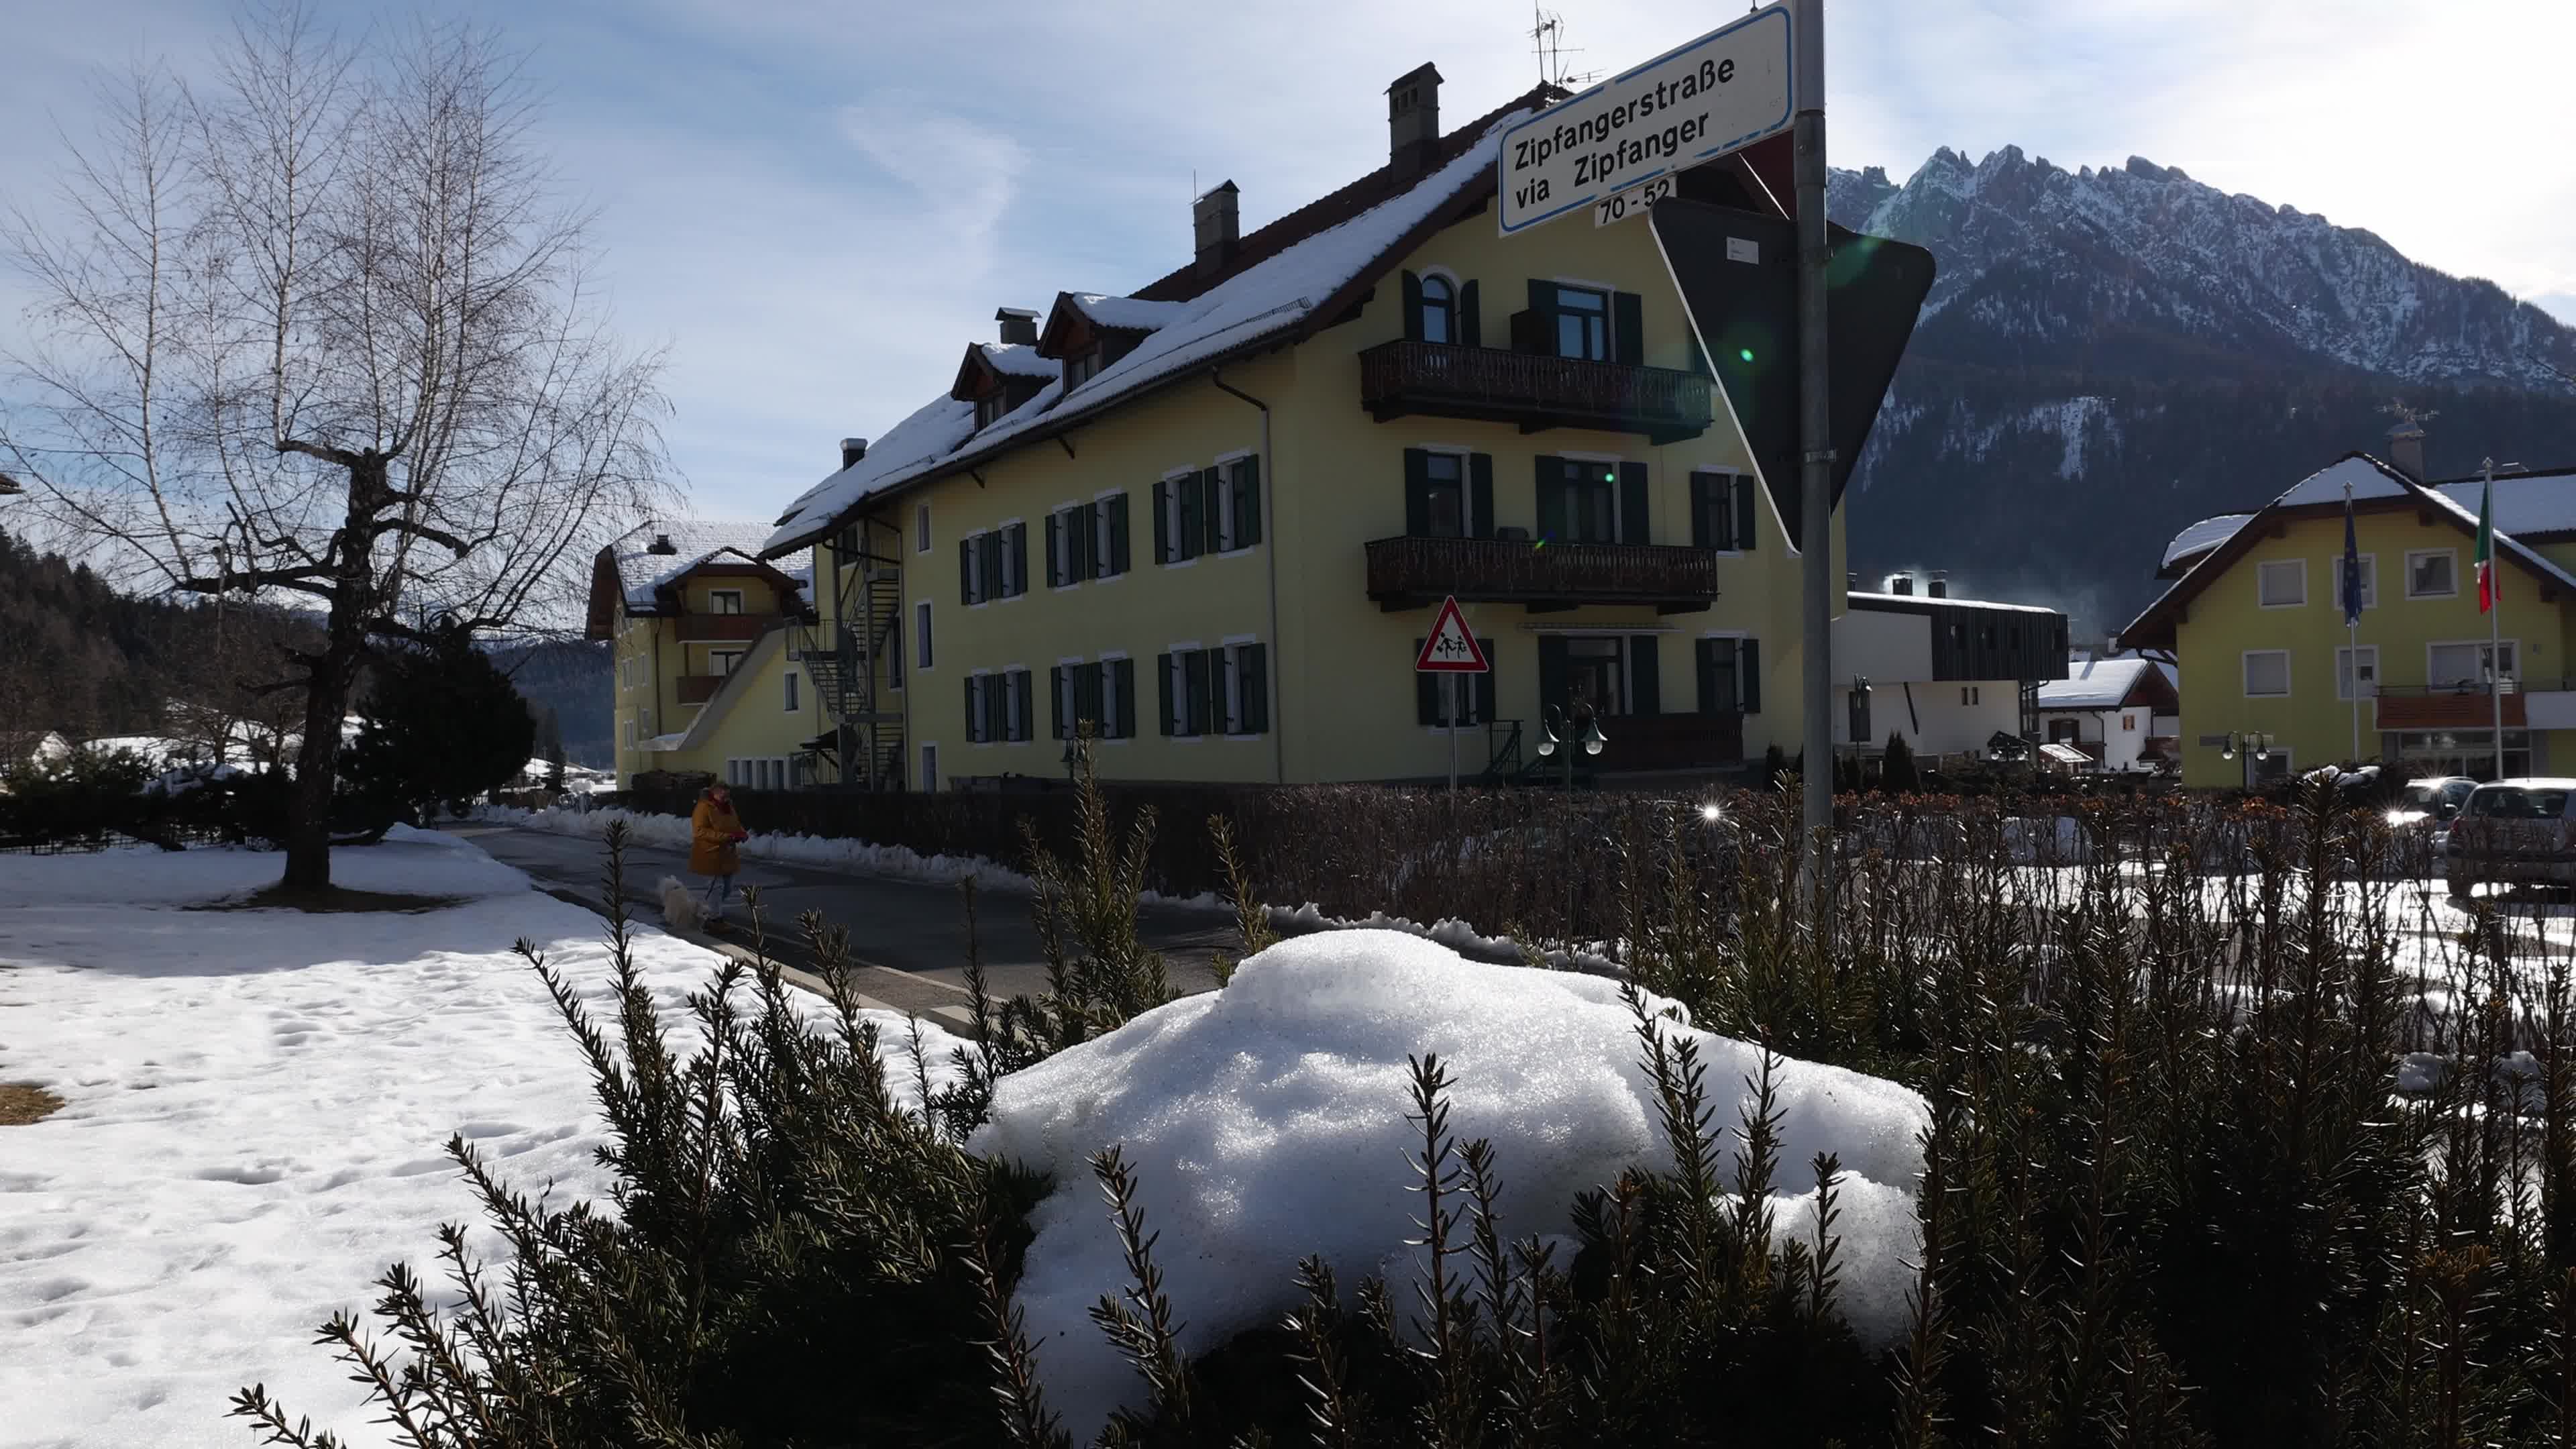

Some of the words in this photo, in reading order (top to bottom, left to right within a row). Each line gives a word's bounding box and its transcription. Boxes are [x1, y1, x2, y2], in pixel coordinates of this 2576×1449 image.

[1515, 58, 1735, 171] Zipfangerstraße
[1515, 177, 1550, 209] via
[1574, 112, 1709, 187] Zipfanger
[1600, 196, 1625, 224] 70
[1644, 178, 1670, 207] 52
